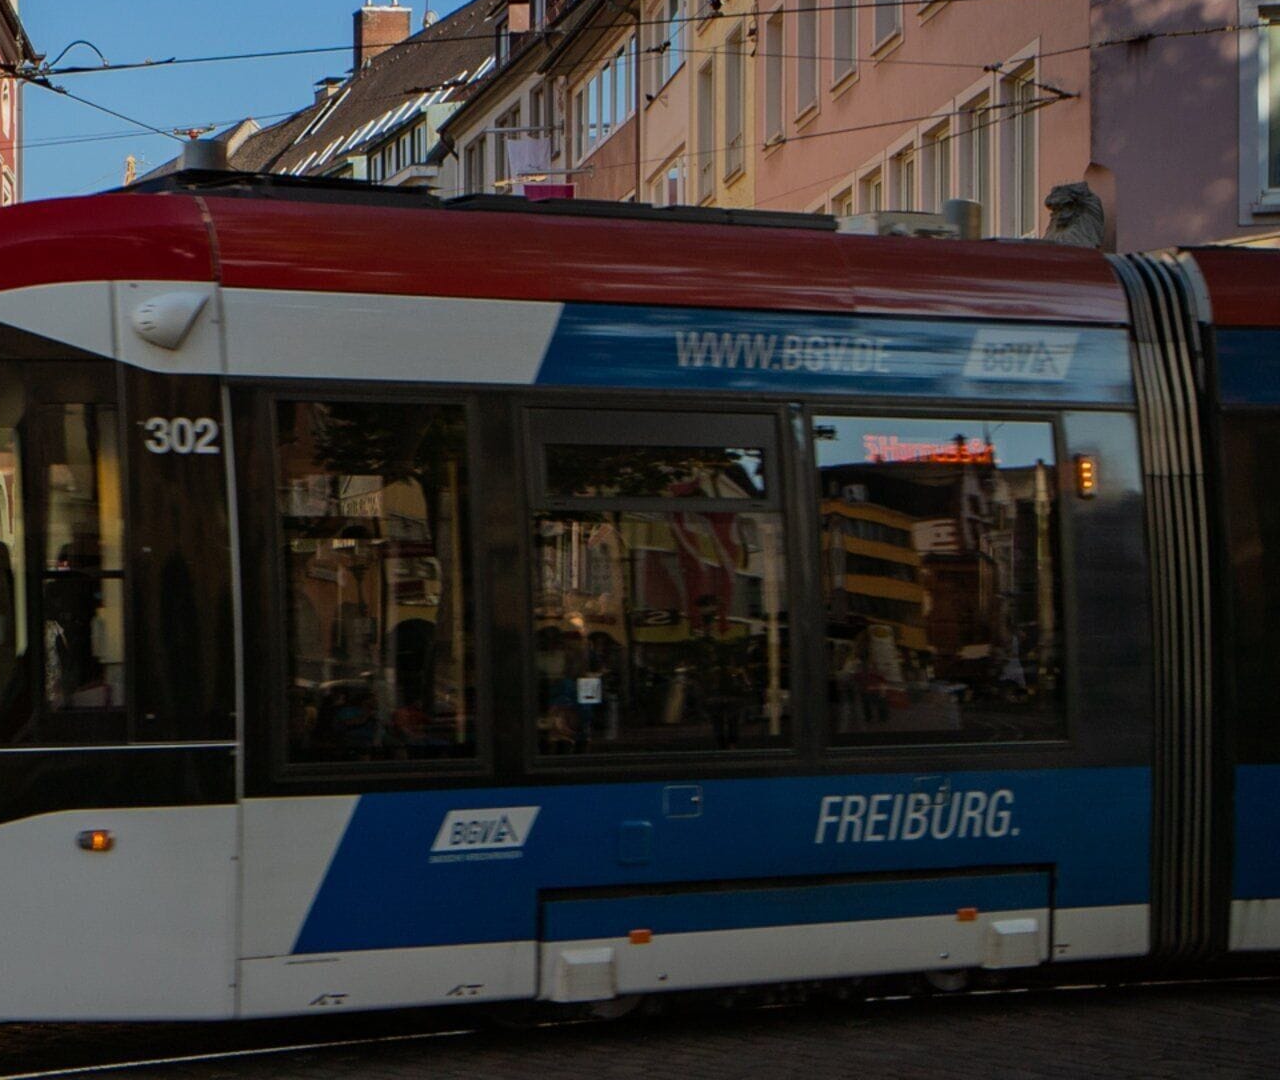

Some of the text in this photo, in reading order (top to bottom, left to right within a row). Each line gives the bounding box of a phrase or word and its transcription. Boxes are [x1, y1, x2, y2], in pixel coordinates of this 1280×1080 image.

[674, 330, 891, 373] WWW.BGV.DE
[144, 416, 220, 454] 302
[814, 788, 1021, 844] FREIBURG.
